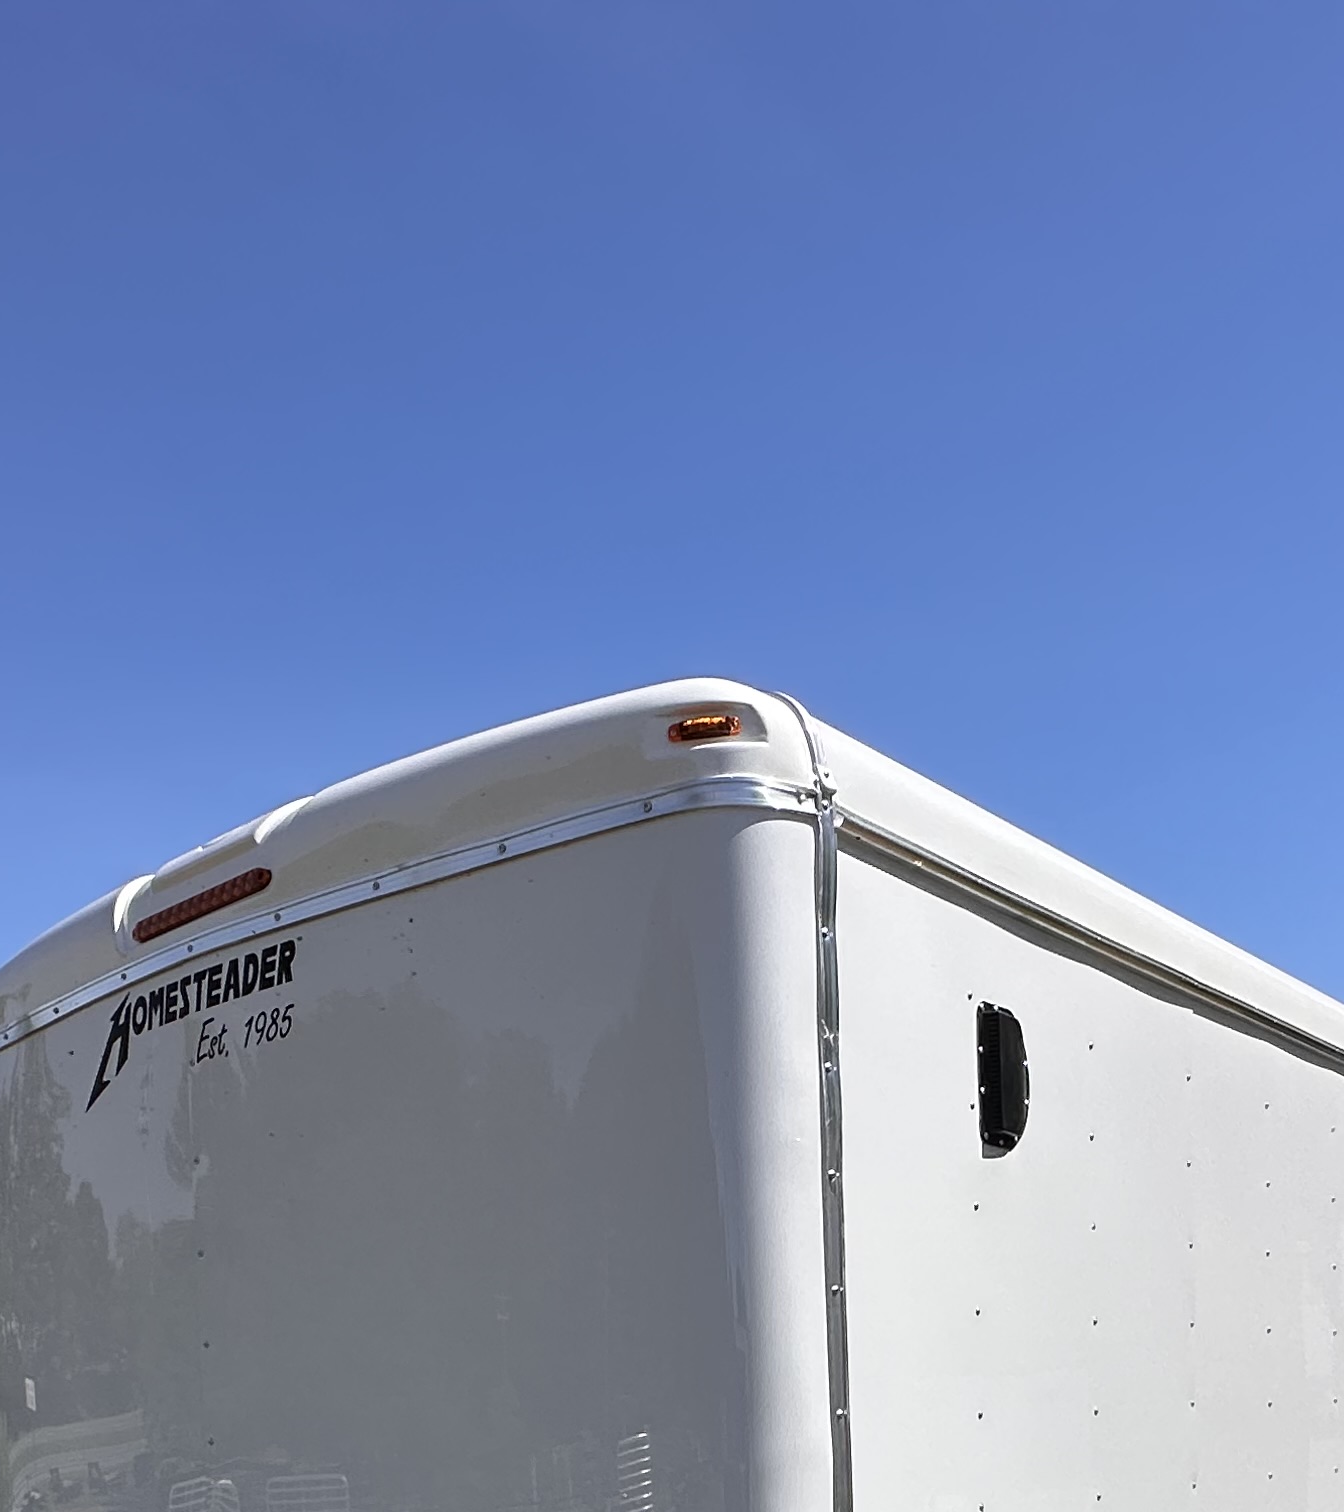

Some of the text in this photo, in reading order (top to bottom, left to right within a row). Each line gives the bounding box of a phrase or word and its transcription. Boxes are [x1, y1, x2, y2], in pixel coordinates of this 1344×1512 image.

[84, 939, 297, 1113] HOMESTEADER
[196, 1003, 295, 1064] Est. 1985
